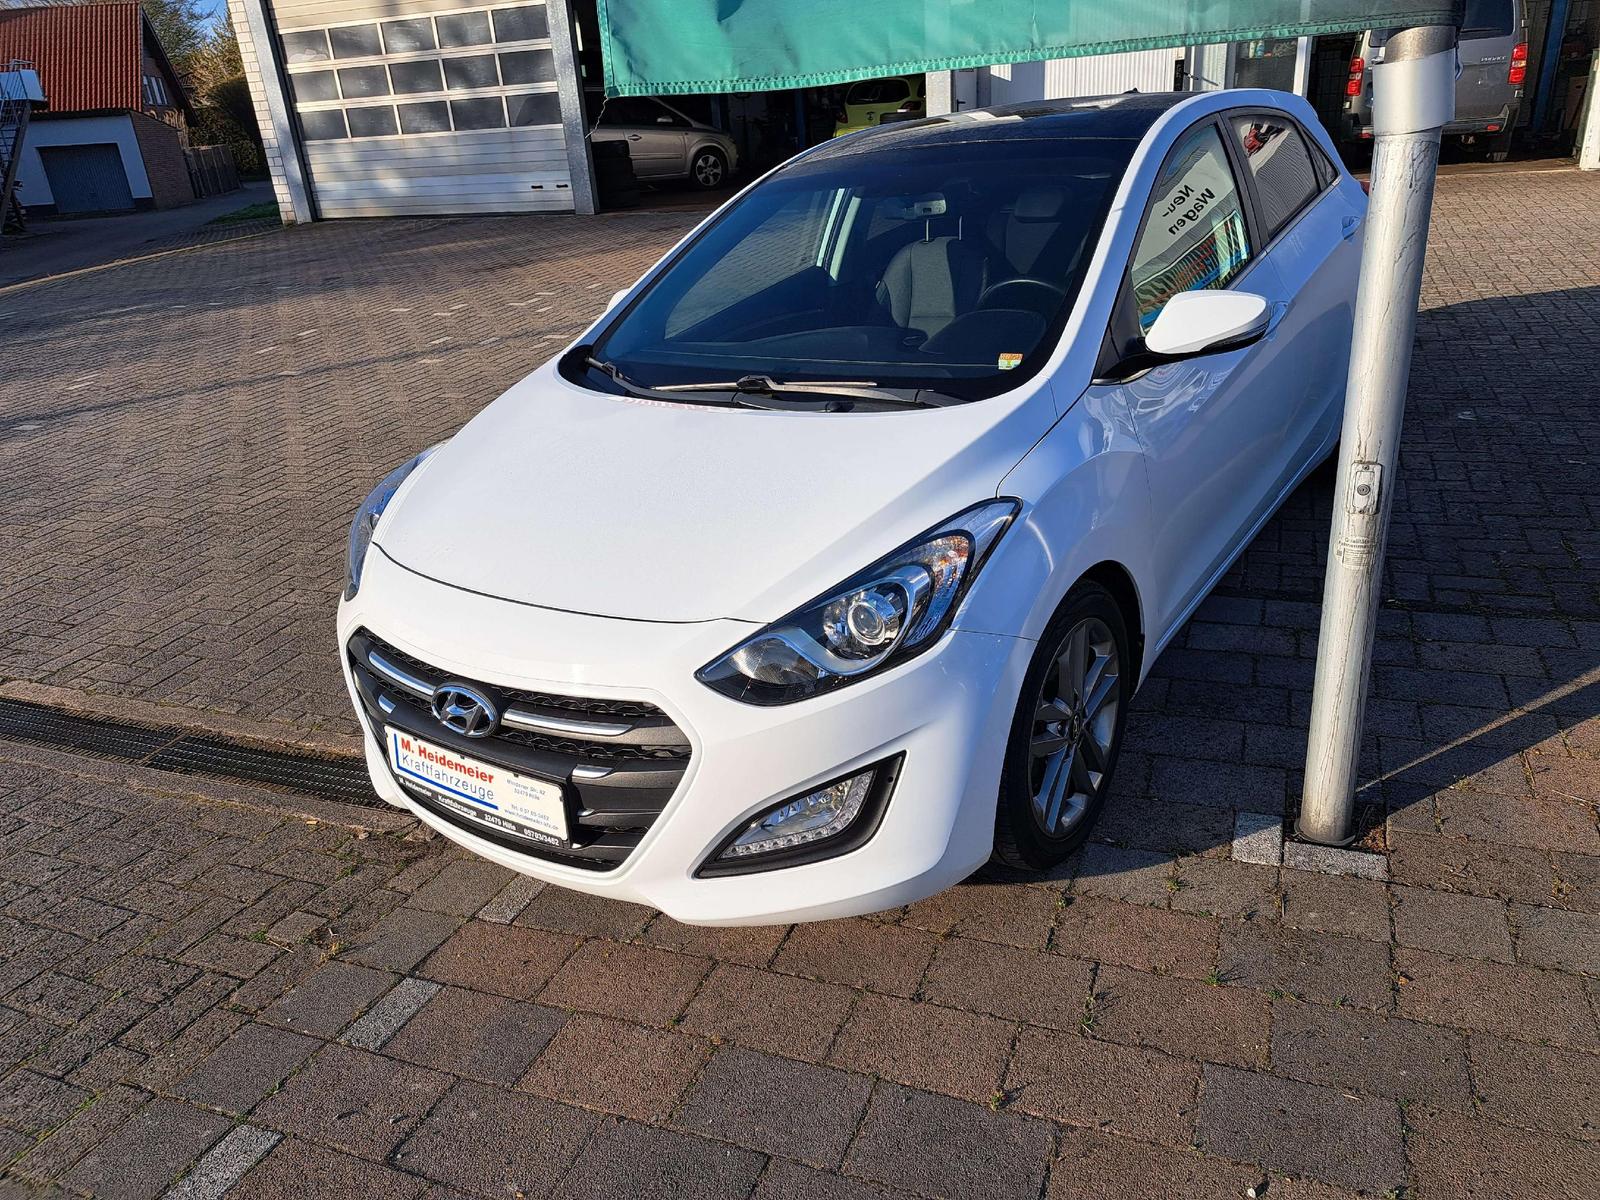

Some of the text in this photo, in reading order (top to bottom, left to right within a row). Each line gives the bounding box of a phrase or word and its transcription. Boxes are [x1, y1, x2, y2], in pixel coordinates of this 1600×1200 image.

[401, 736, 494, 784] M. Heidemeier
[402, 753, 494, 801] Kraftfahrzeuge
